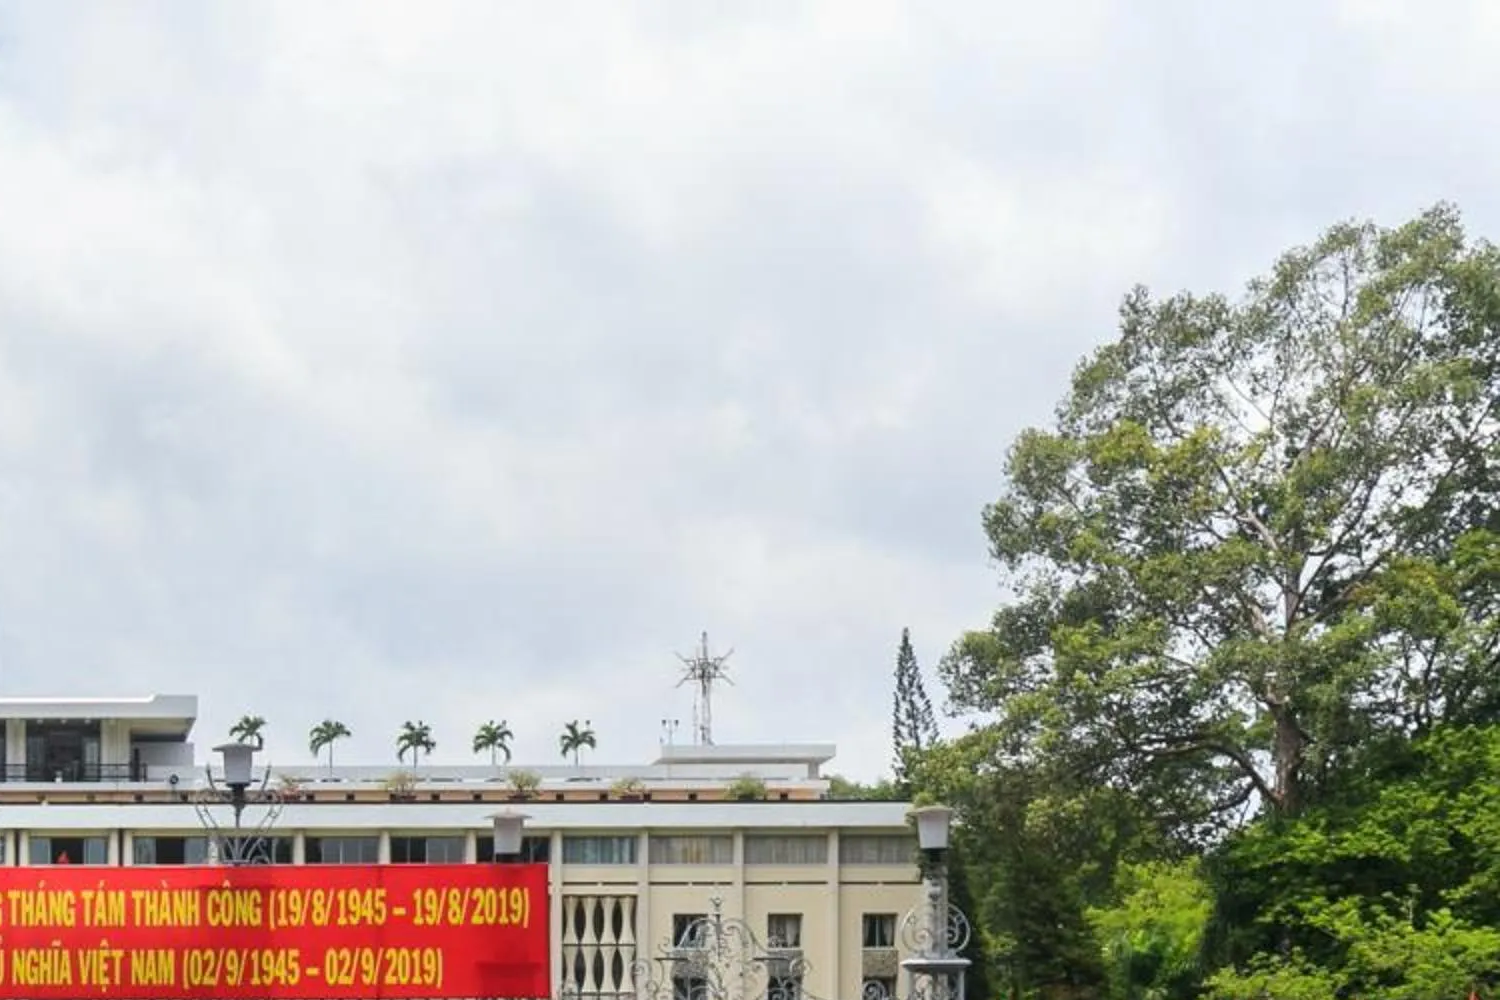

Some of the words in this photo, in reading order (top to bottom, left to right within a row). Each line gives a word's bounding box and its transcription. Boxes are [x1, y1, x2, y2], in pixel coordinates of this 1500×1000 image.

[8, 880, 76, 927] THÁNG
[81, 880, 125, 927] TÁM
[132, 880, 200, 927] THÀNH
[207, 880, 262, 927] CÔNG
[270, 887, 387, 929] (19/8/1945
[413, 887, 530, 929] 19/8/2019)
[12, 939, 72, 985] NGHĨA
[79, 939, 123, 992] VIỆT
[131, 949, 174, 985] NAM
[184, 948, 300, 990] (02/9/1945
[325, 947, 443, 989] 02/9/2019)
